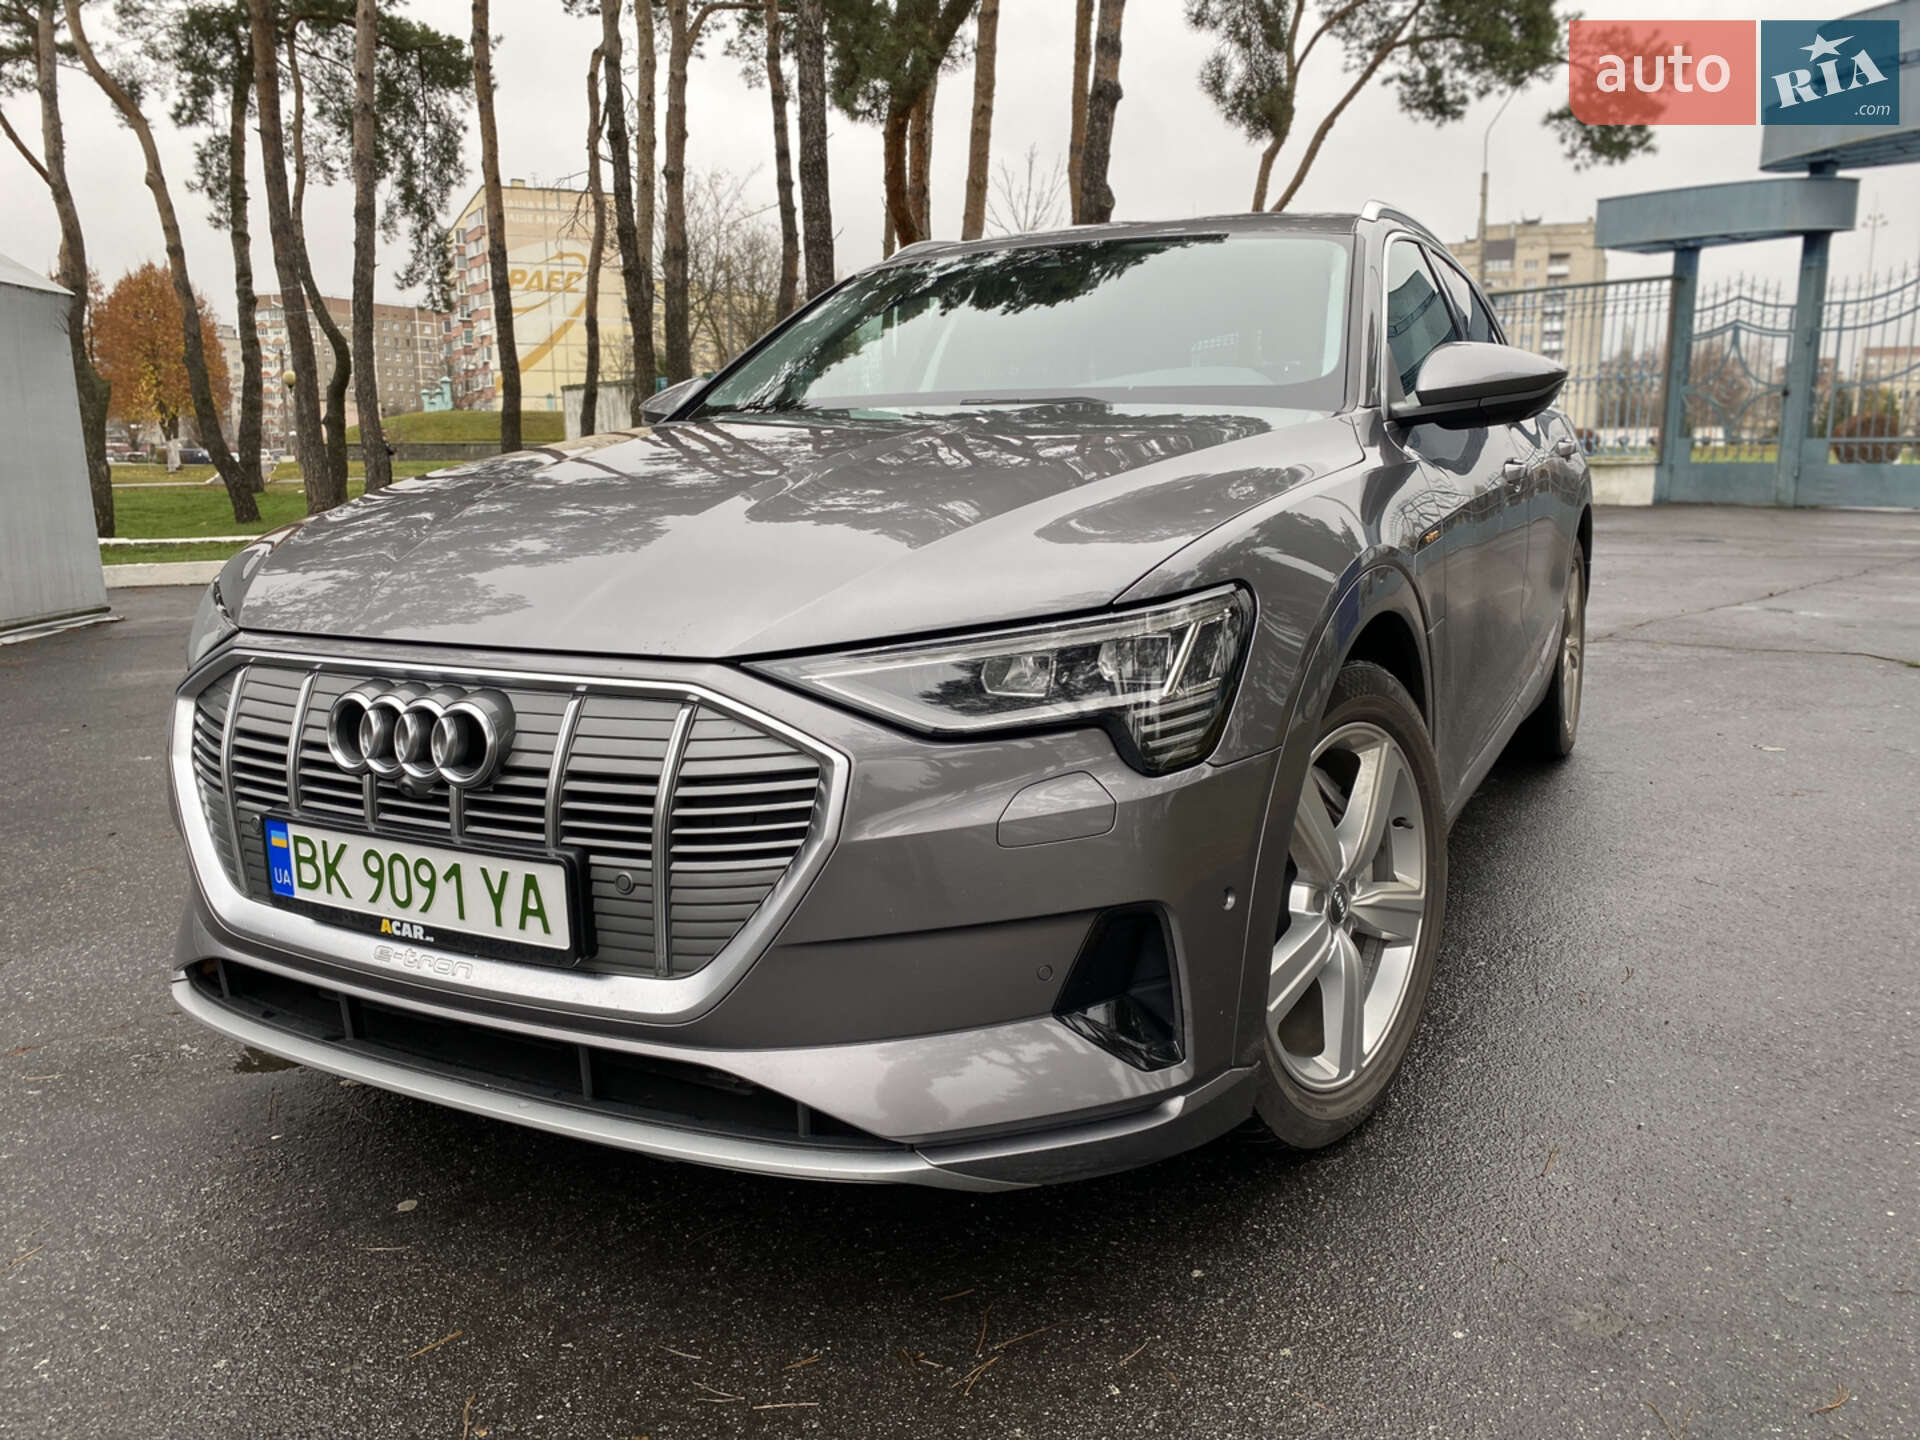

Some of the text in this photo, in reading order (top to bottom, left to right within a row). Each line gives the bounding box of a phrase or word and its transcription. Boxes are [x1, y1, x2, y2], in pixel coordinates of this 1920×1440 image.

[275, 867, 292, 887] UA
[292, 834, 552, 935] BK 9091 YA
[374, 944, 474, 980] e-tron
